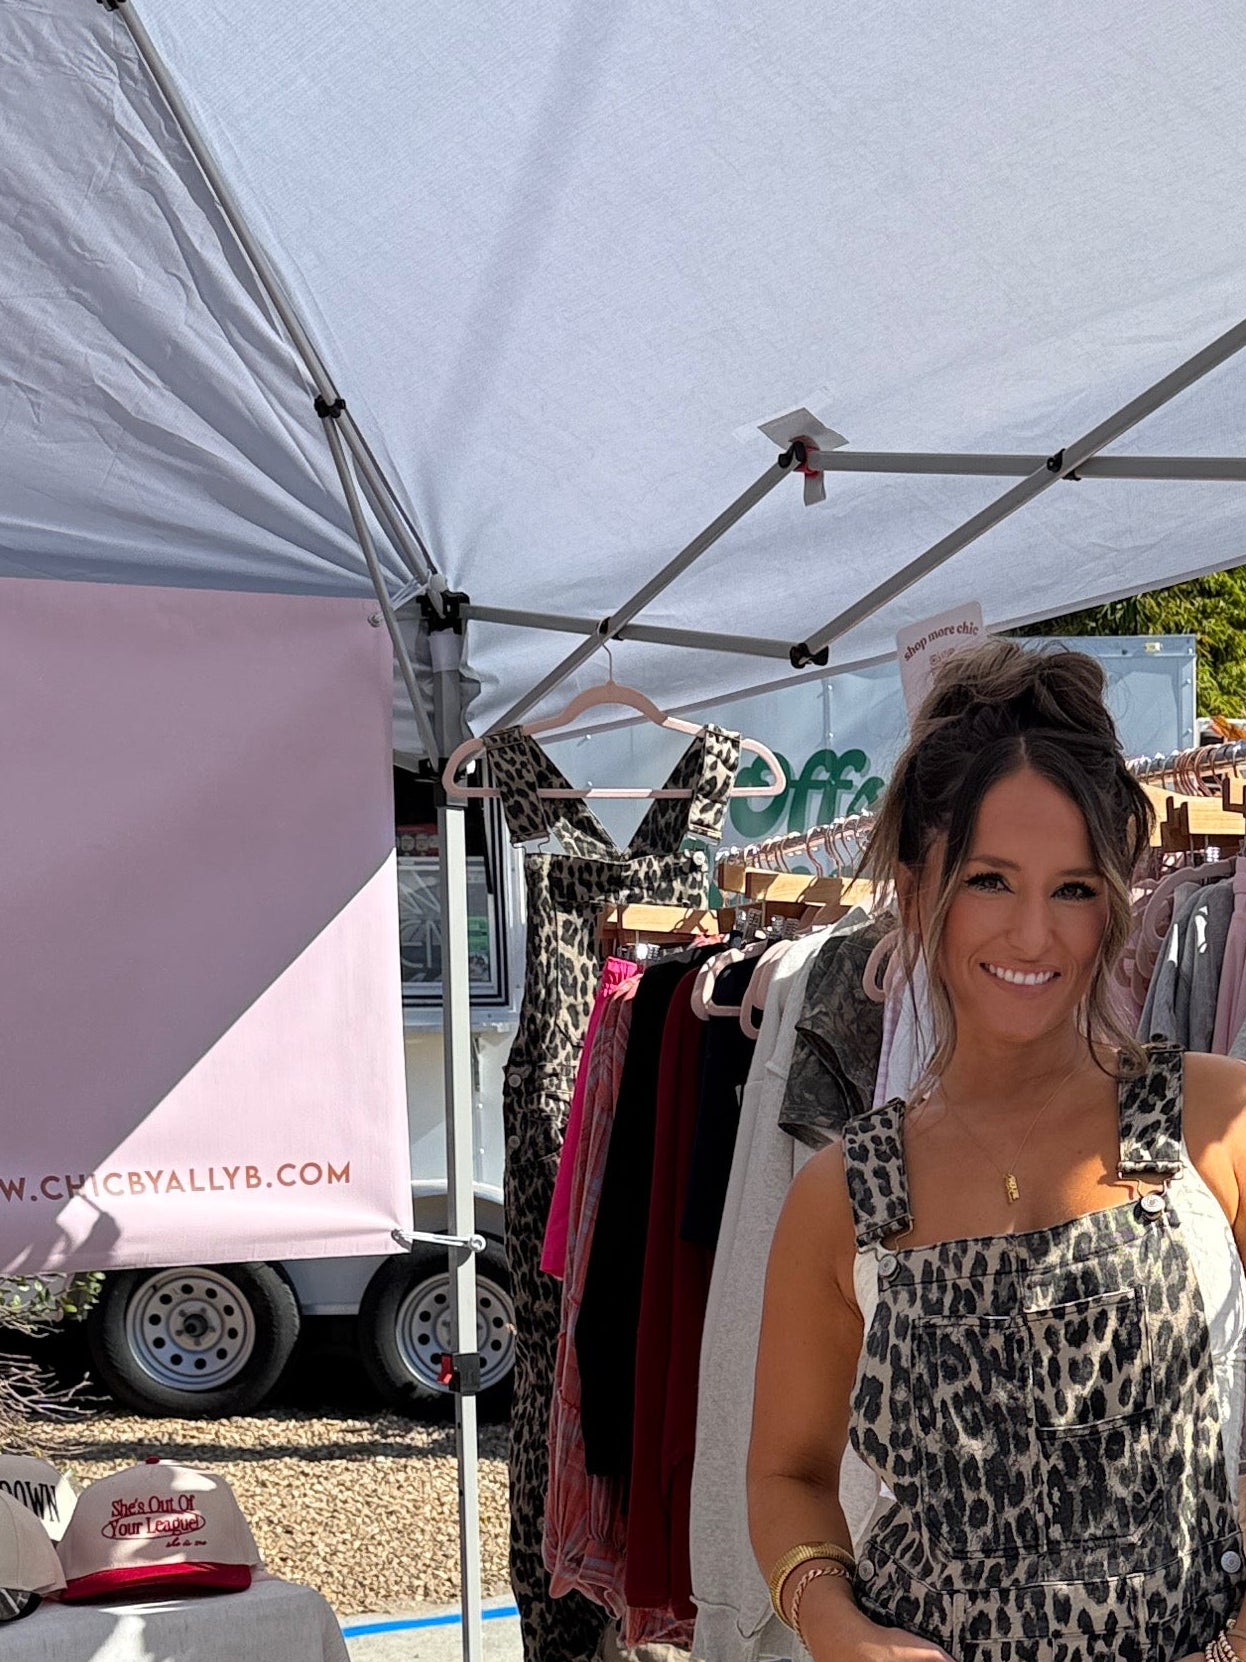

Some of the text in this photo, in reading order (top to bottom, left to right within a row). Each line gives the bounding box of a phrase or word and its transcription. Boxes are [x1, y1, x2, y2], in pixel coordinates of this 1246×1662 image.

[904, 621, 979, 661] shop more chic
[112, 1494, 195, 1517] She's Out Of
[110, 1519, 143, 1537] Your
